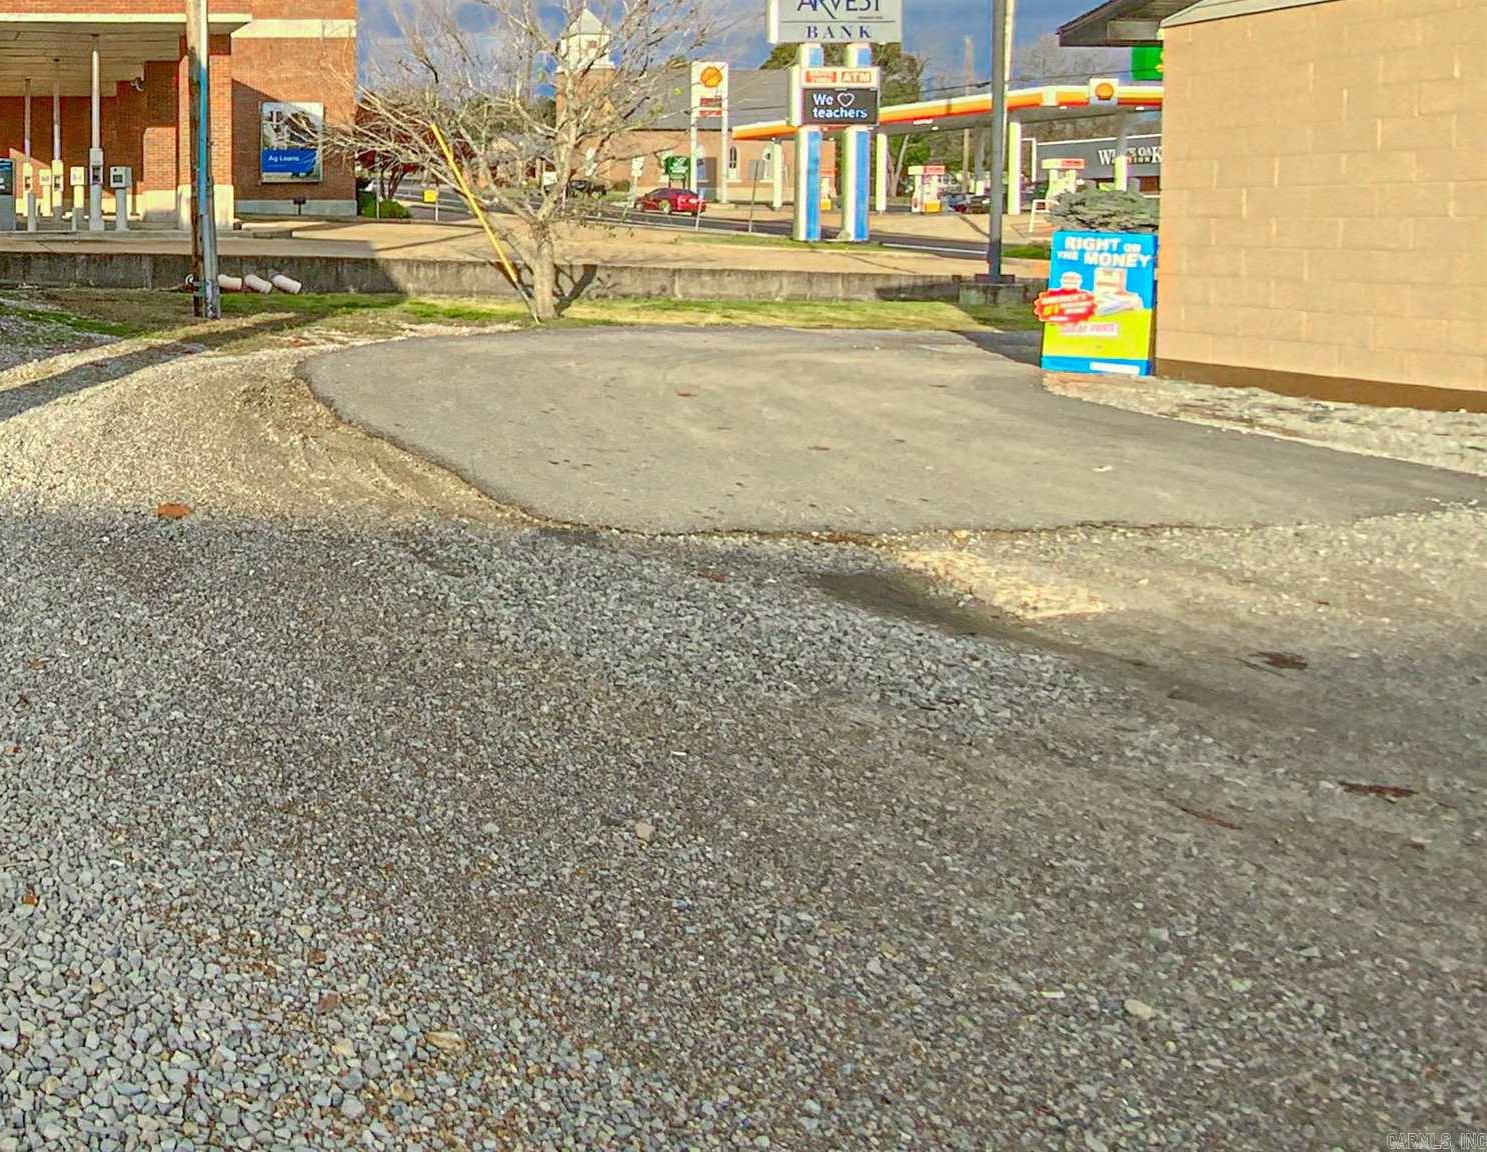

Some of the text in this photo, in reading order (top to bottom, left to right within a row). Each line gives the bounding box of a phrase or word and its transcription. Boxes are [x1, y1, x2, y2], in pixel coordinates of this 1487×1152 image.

[807, 26, 872, 39] BANK
[842, 72, 871, 83] ATM
[813, 94, 834, 105] We
[812, 107, 868, 118] teachers
[1065, 236, 1121, 251] RIGHT
[1084, 252, 1152, 268] MONEY
